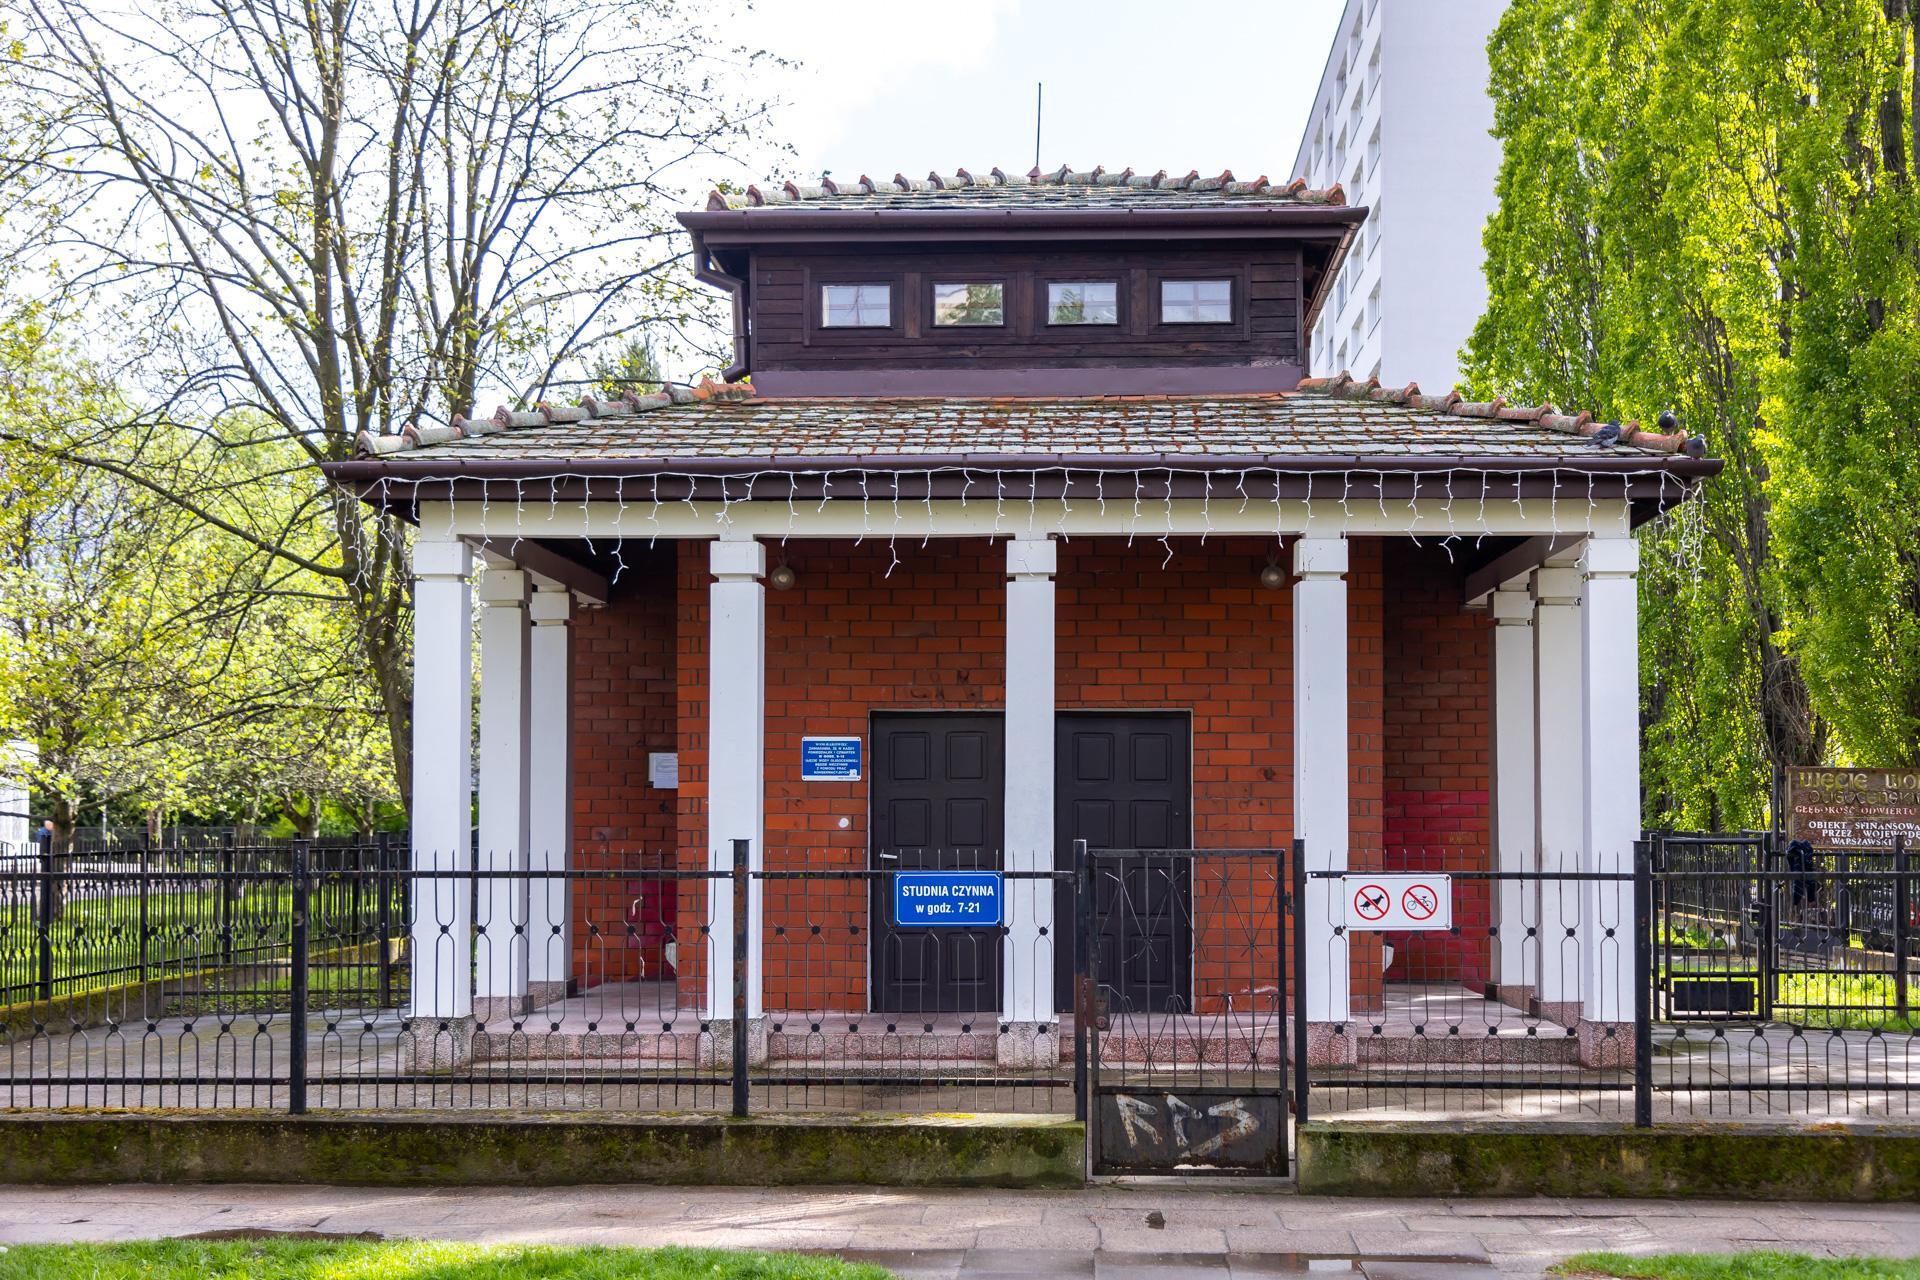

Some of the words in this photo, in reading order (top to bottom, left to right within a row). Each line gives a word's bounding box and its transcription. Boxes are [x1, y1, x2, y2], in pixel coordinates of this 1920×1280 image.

[902, 886, 949, 896] STUDNIA
[952, 886, 994, 896] CZYNNA
[916, 904, 924, 913] w
[928, 902, 954, 915] godz.
[958, 902, 980, 913] 7-21
